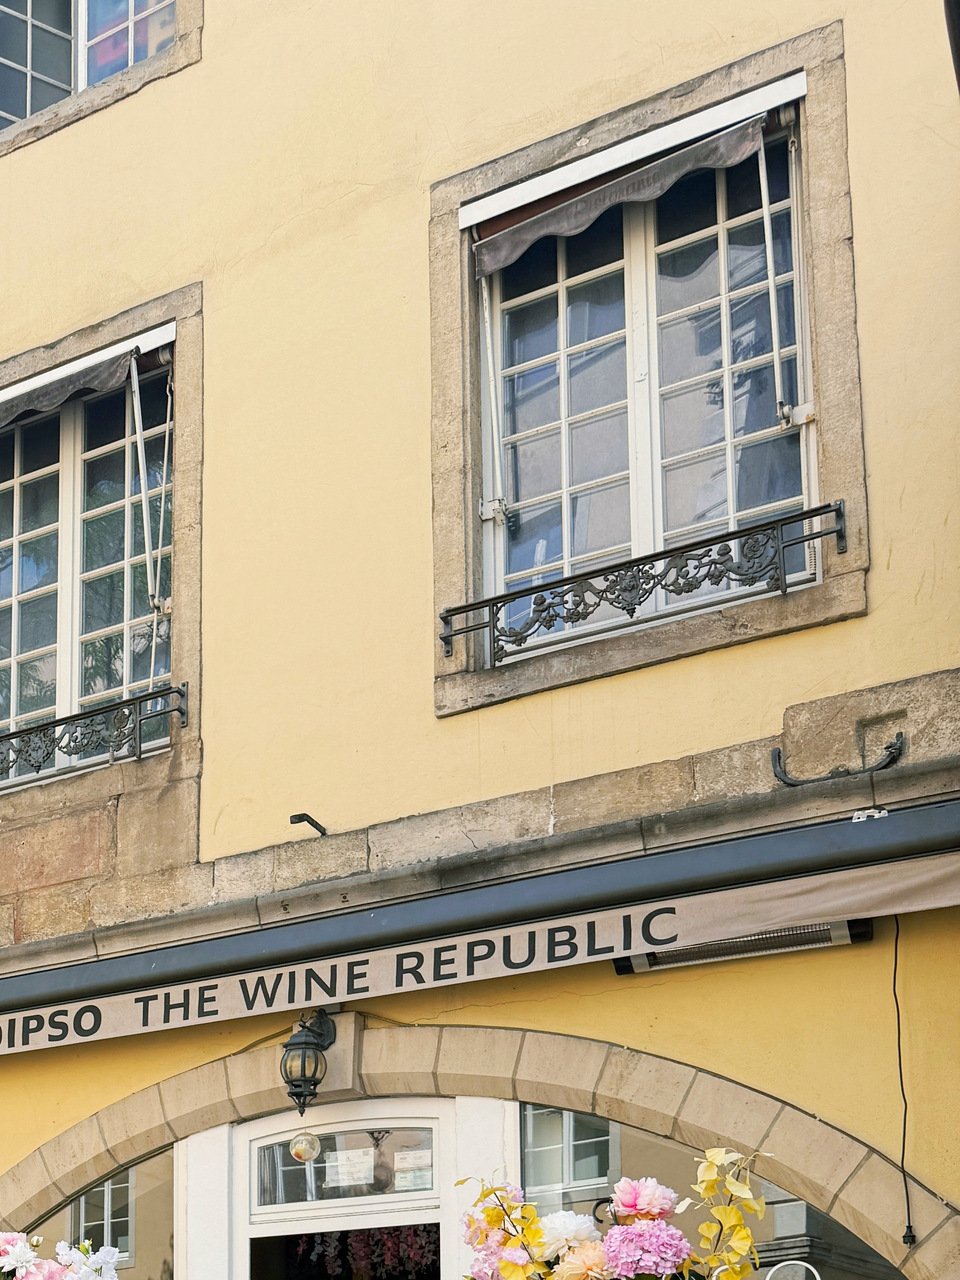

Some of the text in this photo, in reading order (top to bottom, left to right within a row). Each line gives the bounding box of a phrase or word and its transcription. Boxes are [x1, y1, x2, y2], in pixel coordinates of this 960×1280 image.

[135, 984, 219, 1028] THE
[239, 959, 370, 1011] WINE
[395, 907, 679, 988] REPUBLIC
